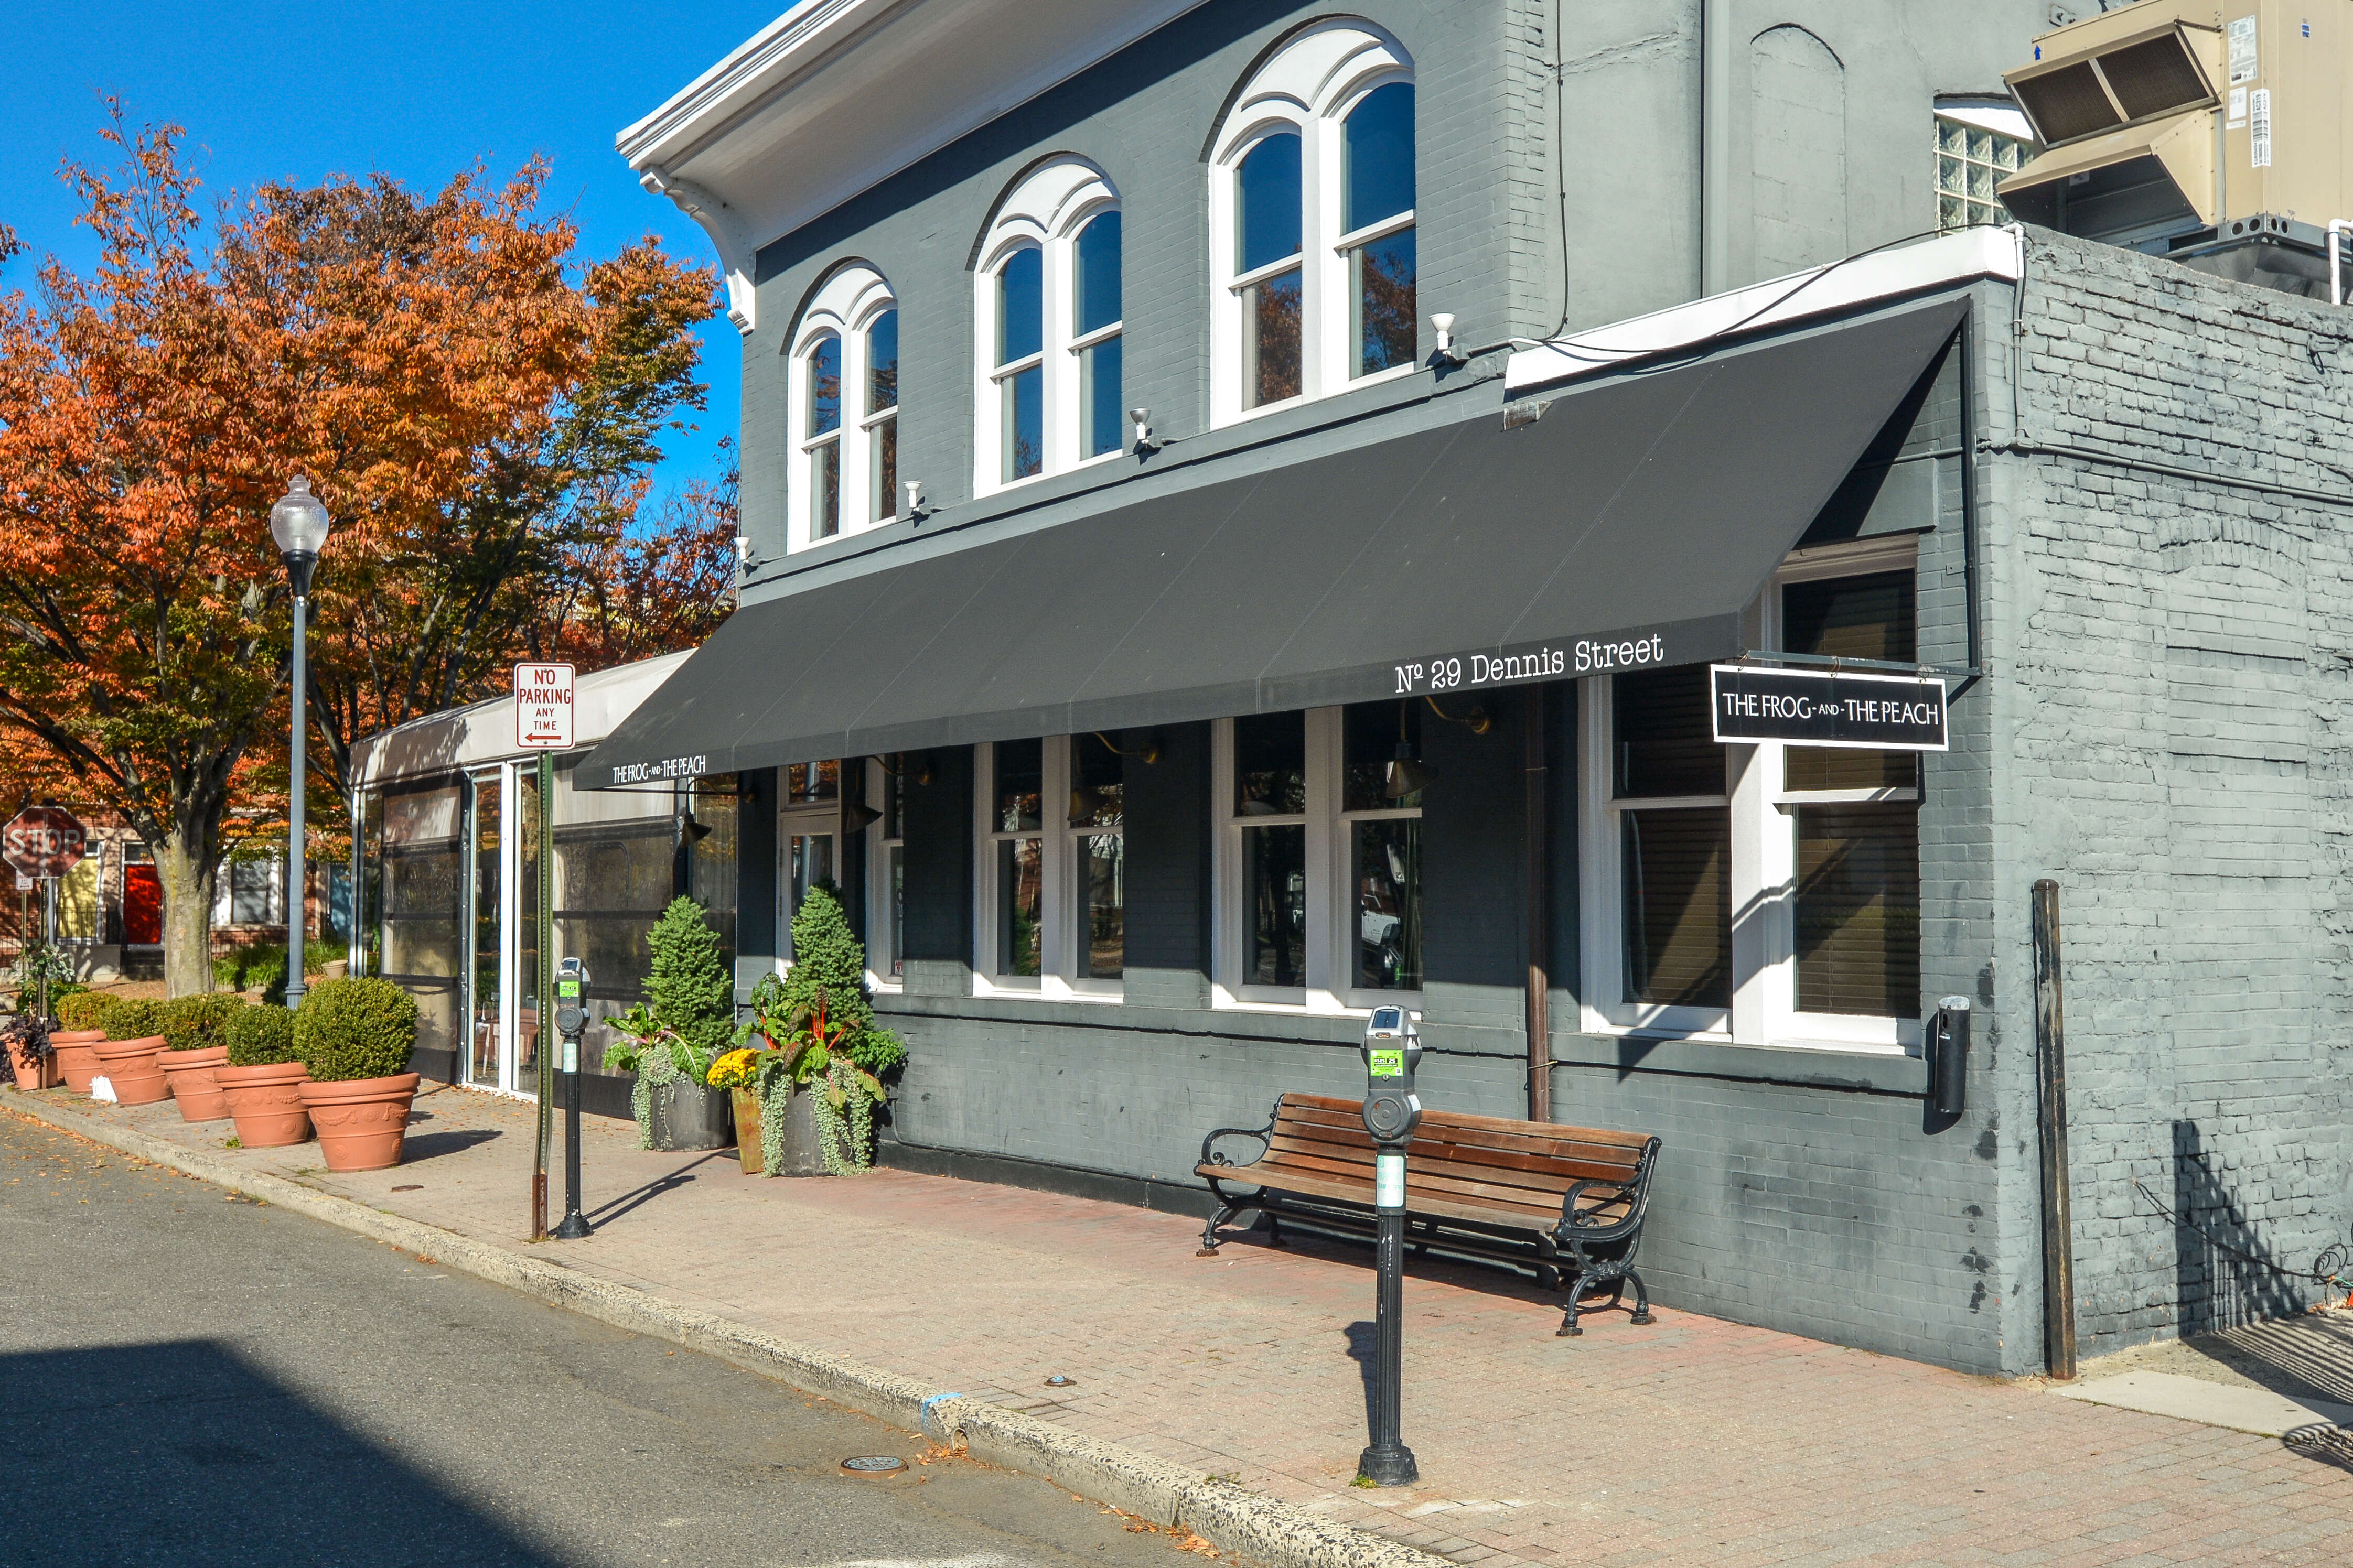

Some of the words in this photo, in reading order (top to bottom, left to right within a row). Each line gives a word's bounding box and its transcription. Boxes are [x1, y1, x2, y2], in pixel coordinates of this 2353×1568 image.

[1431, 658, 1461, 689] 29
[1471, 647, 1564, 684] Dennis
[1575, 633, 1664, 671] Street
[534, 669, 555, 685] NO
[519, 688, 571, 704] PARKING
[536, 708, 554, 717] ANY
[1722, 693, 1759, 716] THE
[1762, 695, 1811, 719] FROG
[1844, 699, 1879, 722] THE
[1881, 701, 1939, 725] PEACH
[534, 721, 556, 730] TIME
[613, 766, 627, 783] THE
[628, 763, 649, 782] FROG
[662, 759, 678, 777] THE
[678, 755, 706, 775] PEACH
[9, 829, 80, 855] STOP
